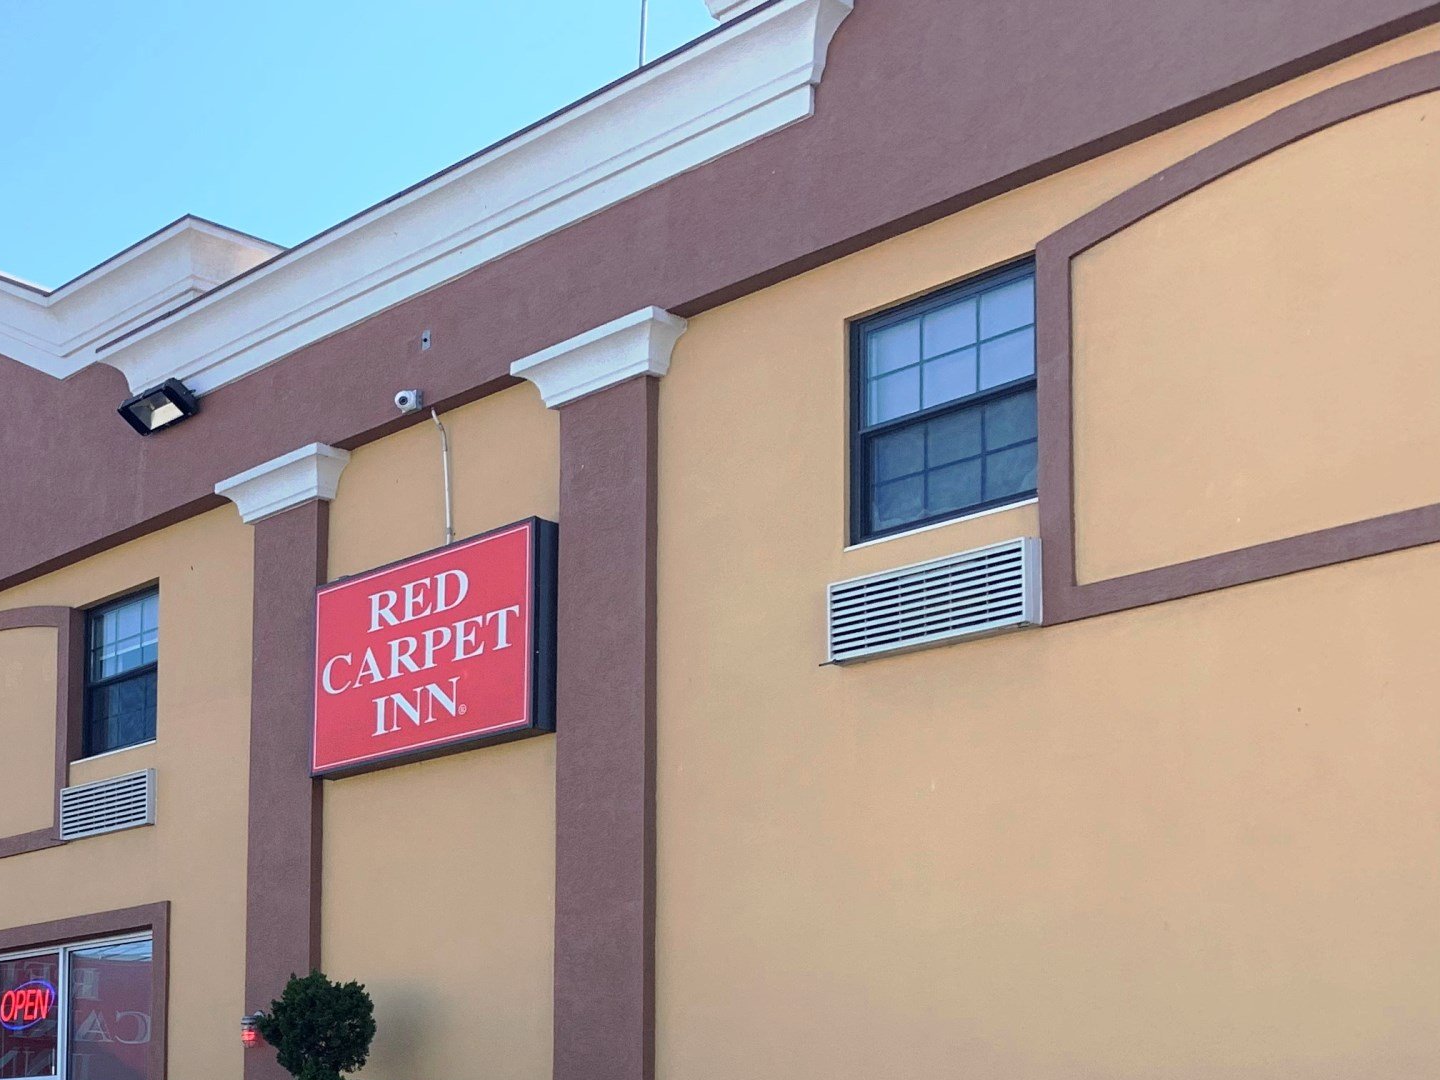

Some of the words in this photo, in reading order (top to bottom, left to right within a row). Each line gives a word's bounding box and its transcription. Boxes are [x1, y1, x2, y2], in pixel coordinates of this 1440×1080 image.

[367, 569, 469, 633] RED
[322, 604, 520, 695] CARPET
[371, 676, 460, 737] INN
[0, 989, 50, 1022] OPEN
